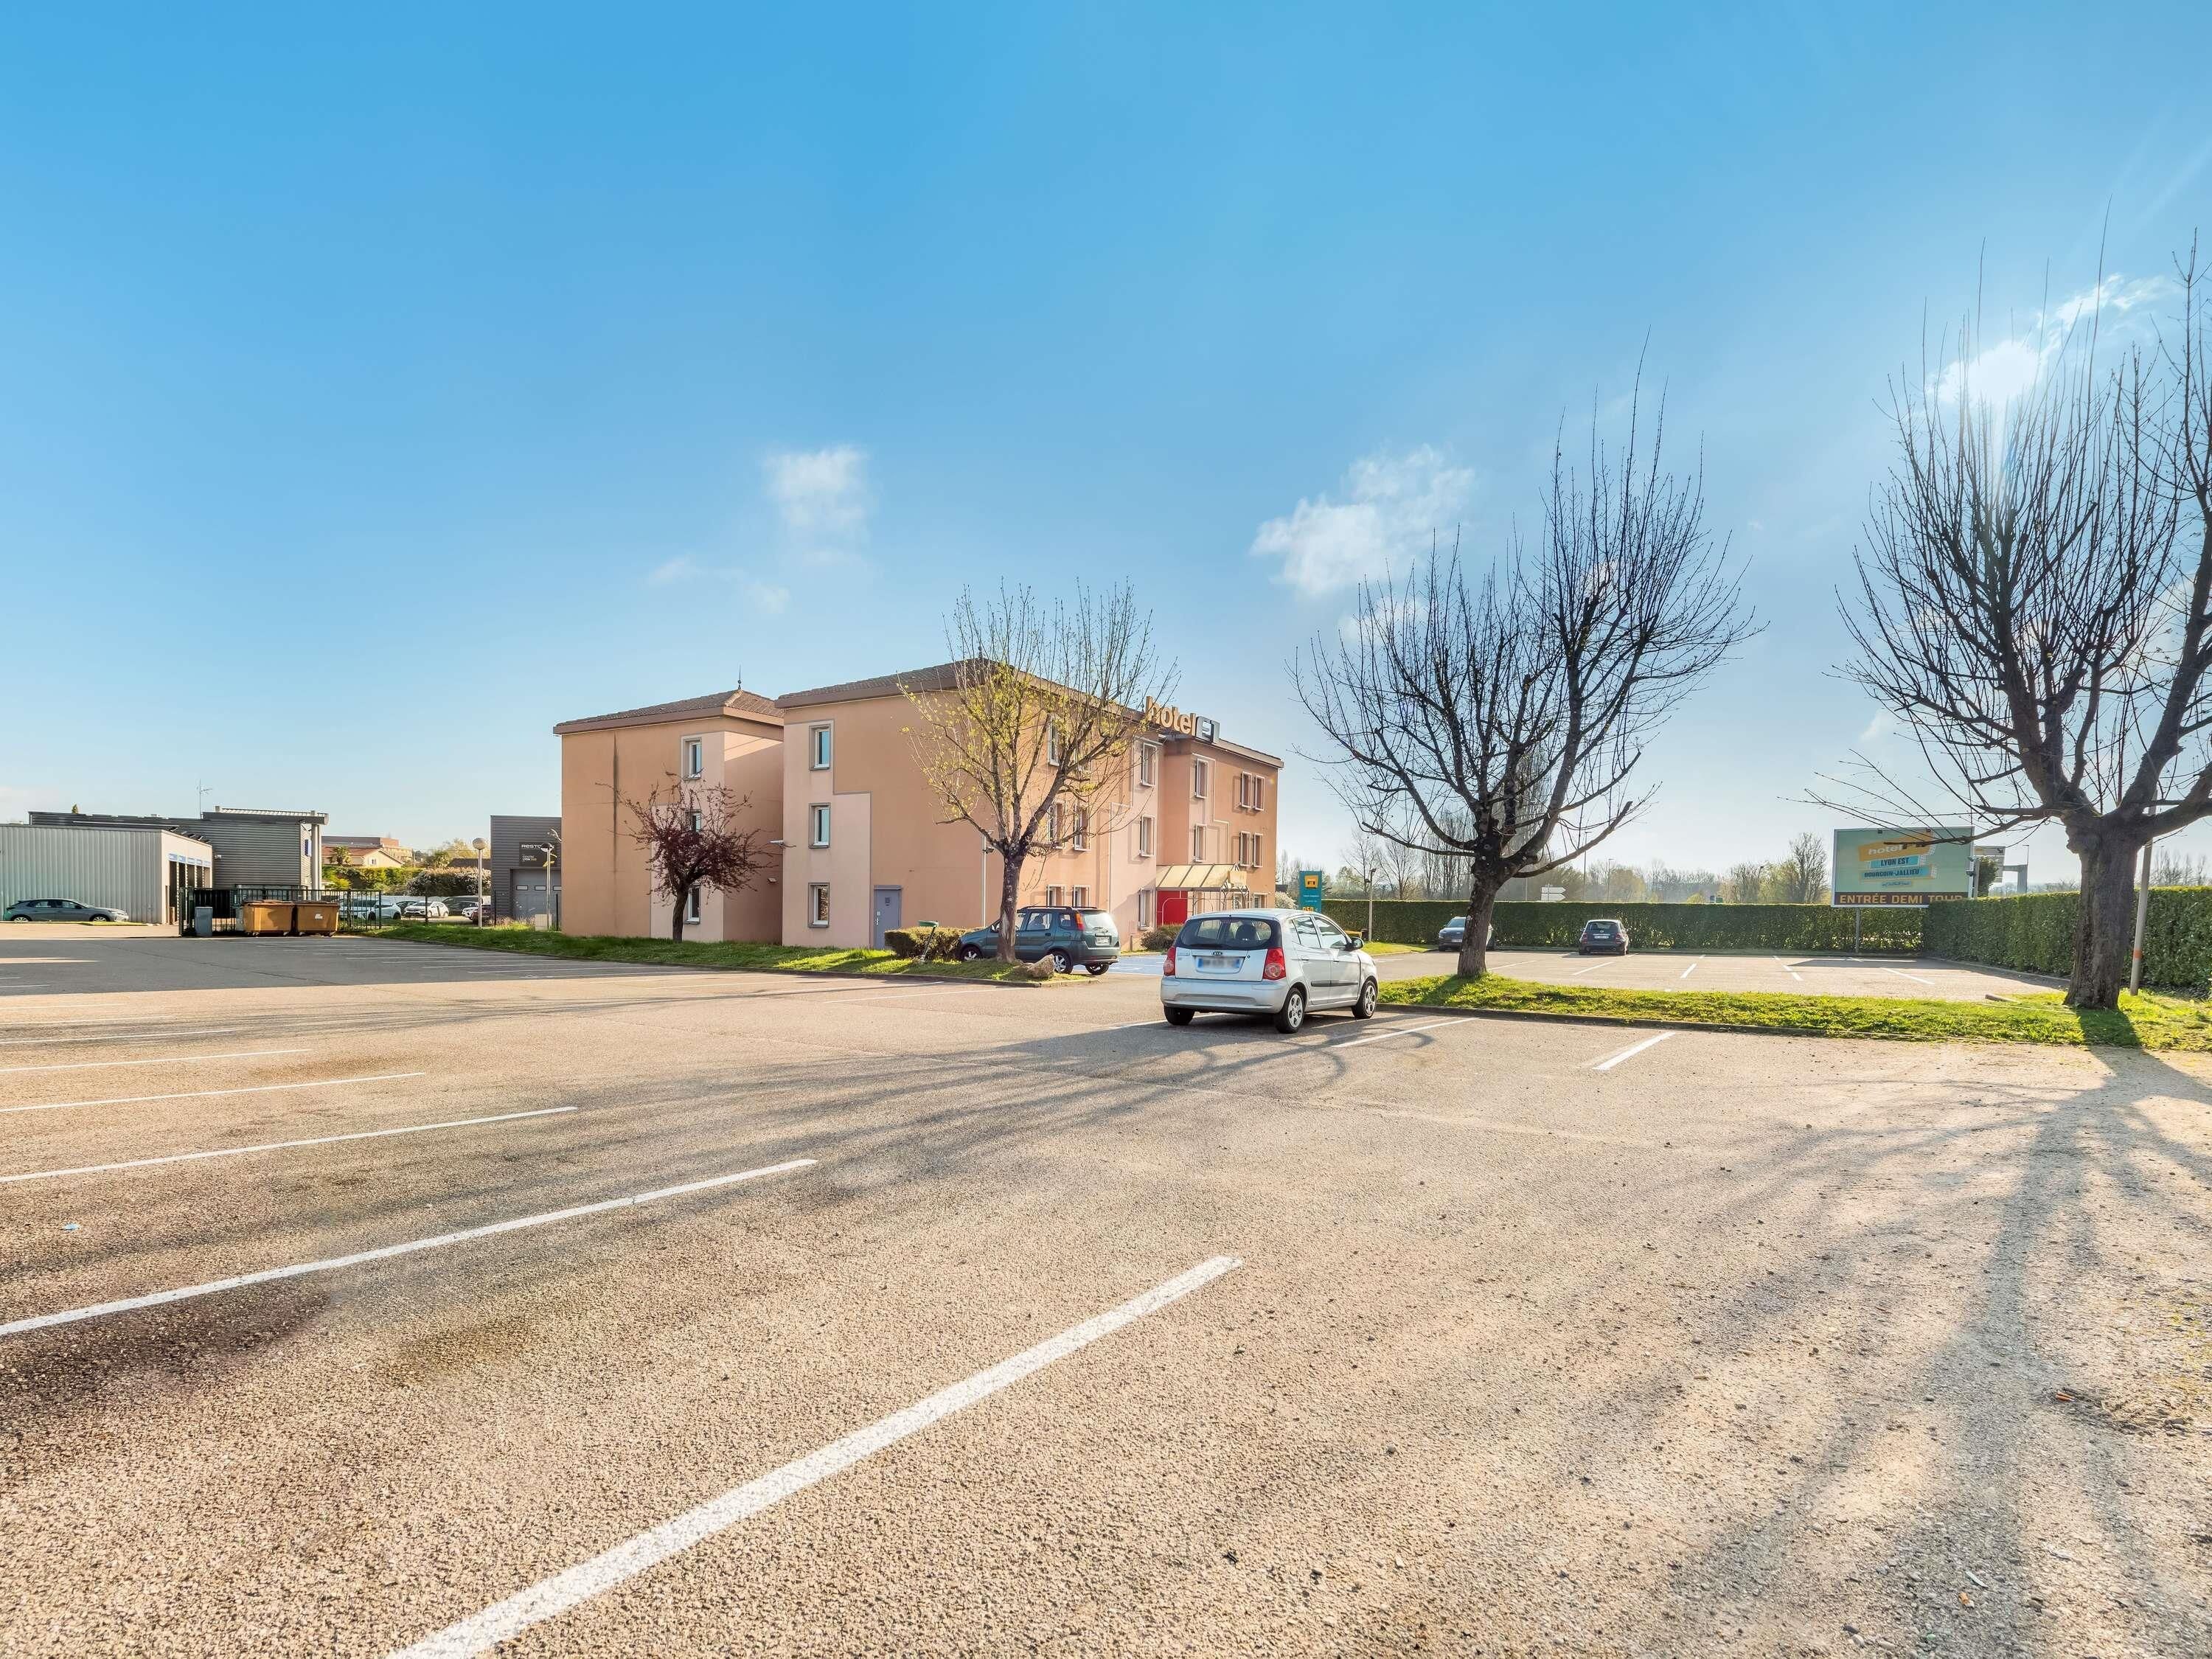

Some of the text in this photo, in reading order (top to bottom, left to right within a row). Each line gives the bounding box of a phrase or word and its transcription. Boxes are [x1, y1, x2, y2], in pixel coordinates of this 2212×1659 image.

[1145, 695, 1196, 736] hotel
[1881, 857, 1909, 866] LYON EST
[1840, 893, 1888, 904] ENTRÉE
[1891, 894, 1923, 904] DEMI
